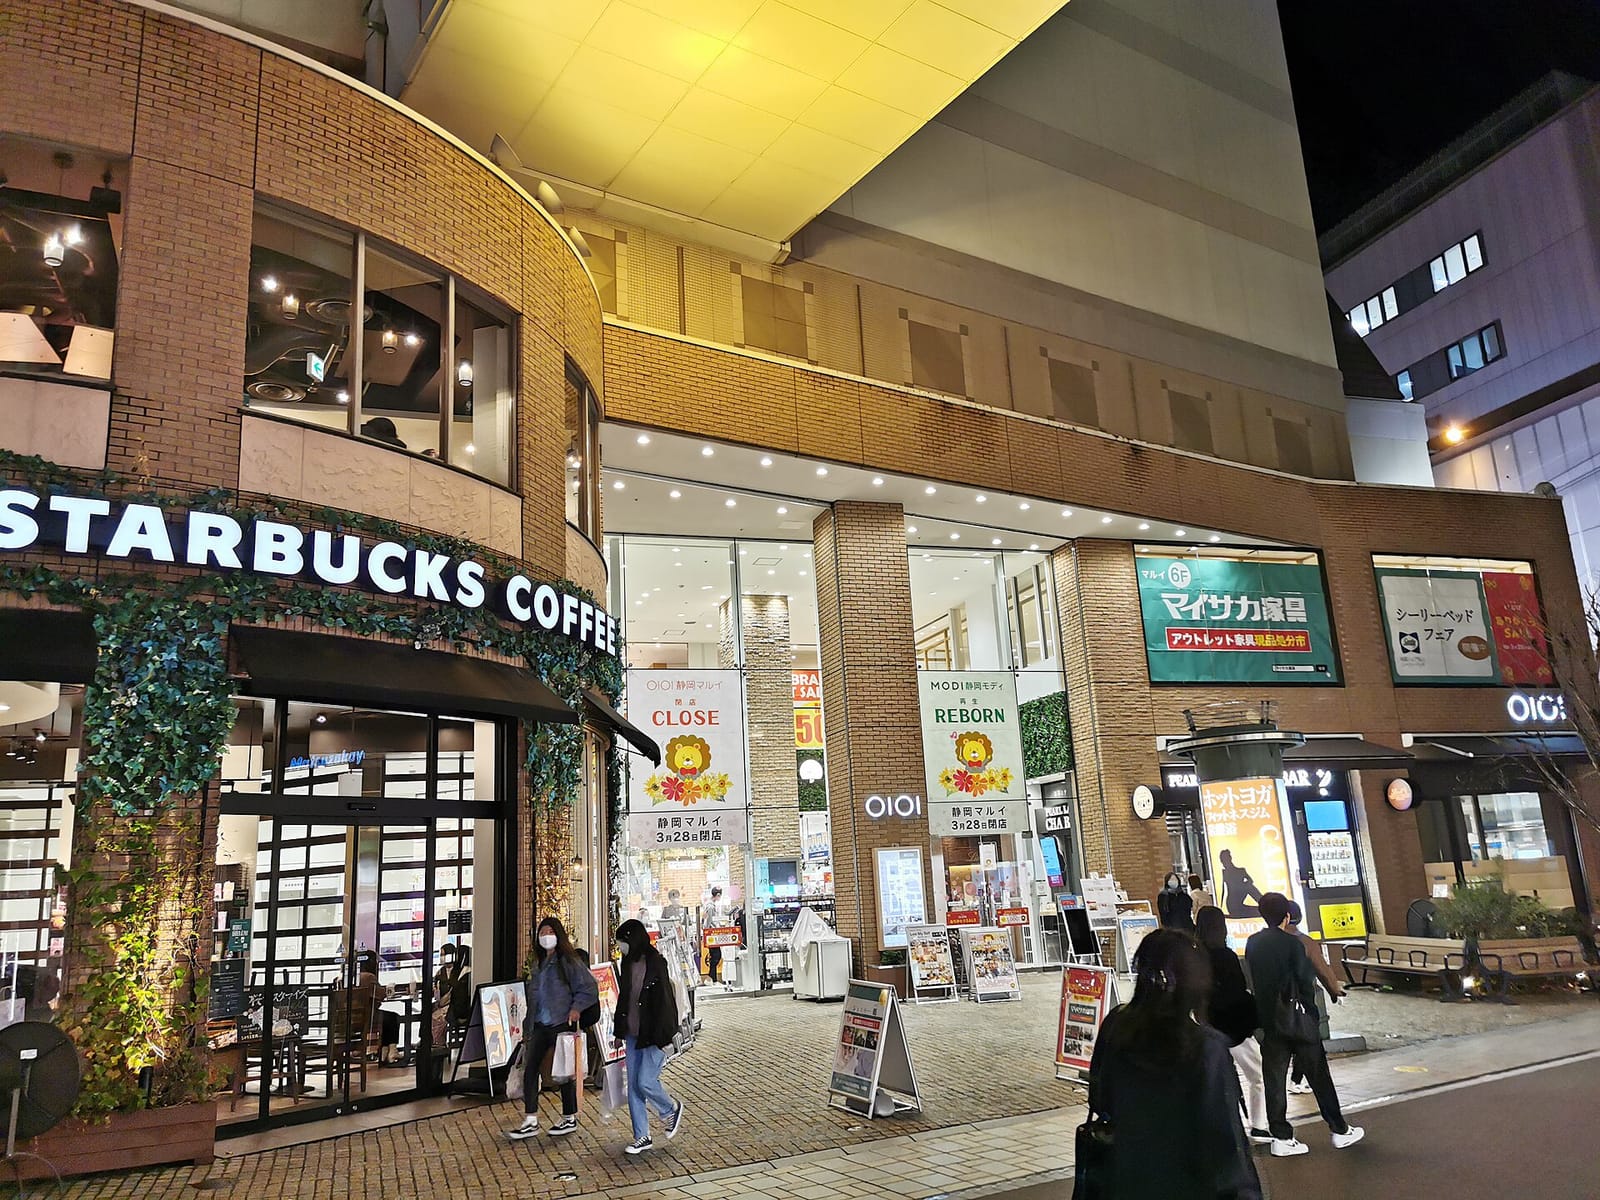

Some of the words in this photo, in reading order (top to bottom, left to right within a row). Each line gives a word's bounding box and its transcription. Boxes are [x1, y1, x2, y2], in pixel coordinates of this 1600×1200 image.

[0, 490, 485, 608] STARBUCKS
[505, 575, 617, 656] COFFEE
[1141, 569, 1166, 580] マルイ
[1170, 566, 1188, 584] 6F
[1160, 593, 1308, 623] マイサカ家具
[1424, 628, 1454, 642] フェア
[676, 679, 722, 690] 静岡マルイ
[930, 681, 964, 691] MODI
[965, 681, 1004, 691] 静岡モディ
[652, 710, 720, 726] CLOSE
[935, 708, 1006, 724] REBORN
[1203, 785, 1273, 809] ホットヨガ
[952, 806, 1006, 817] 静岡マルイ
[657, 815, 722, 829] 静岡マルイ
[952, 819, 1007, 830] 3月28日閉店
[656, 830, 722, 843] 3月28日閉店
